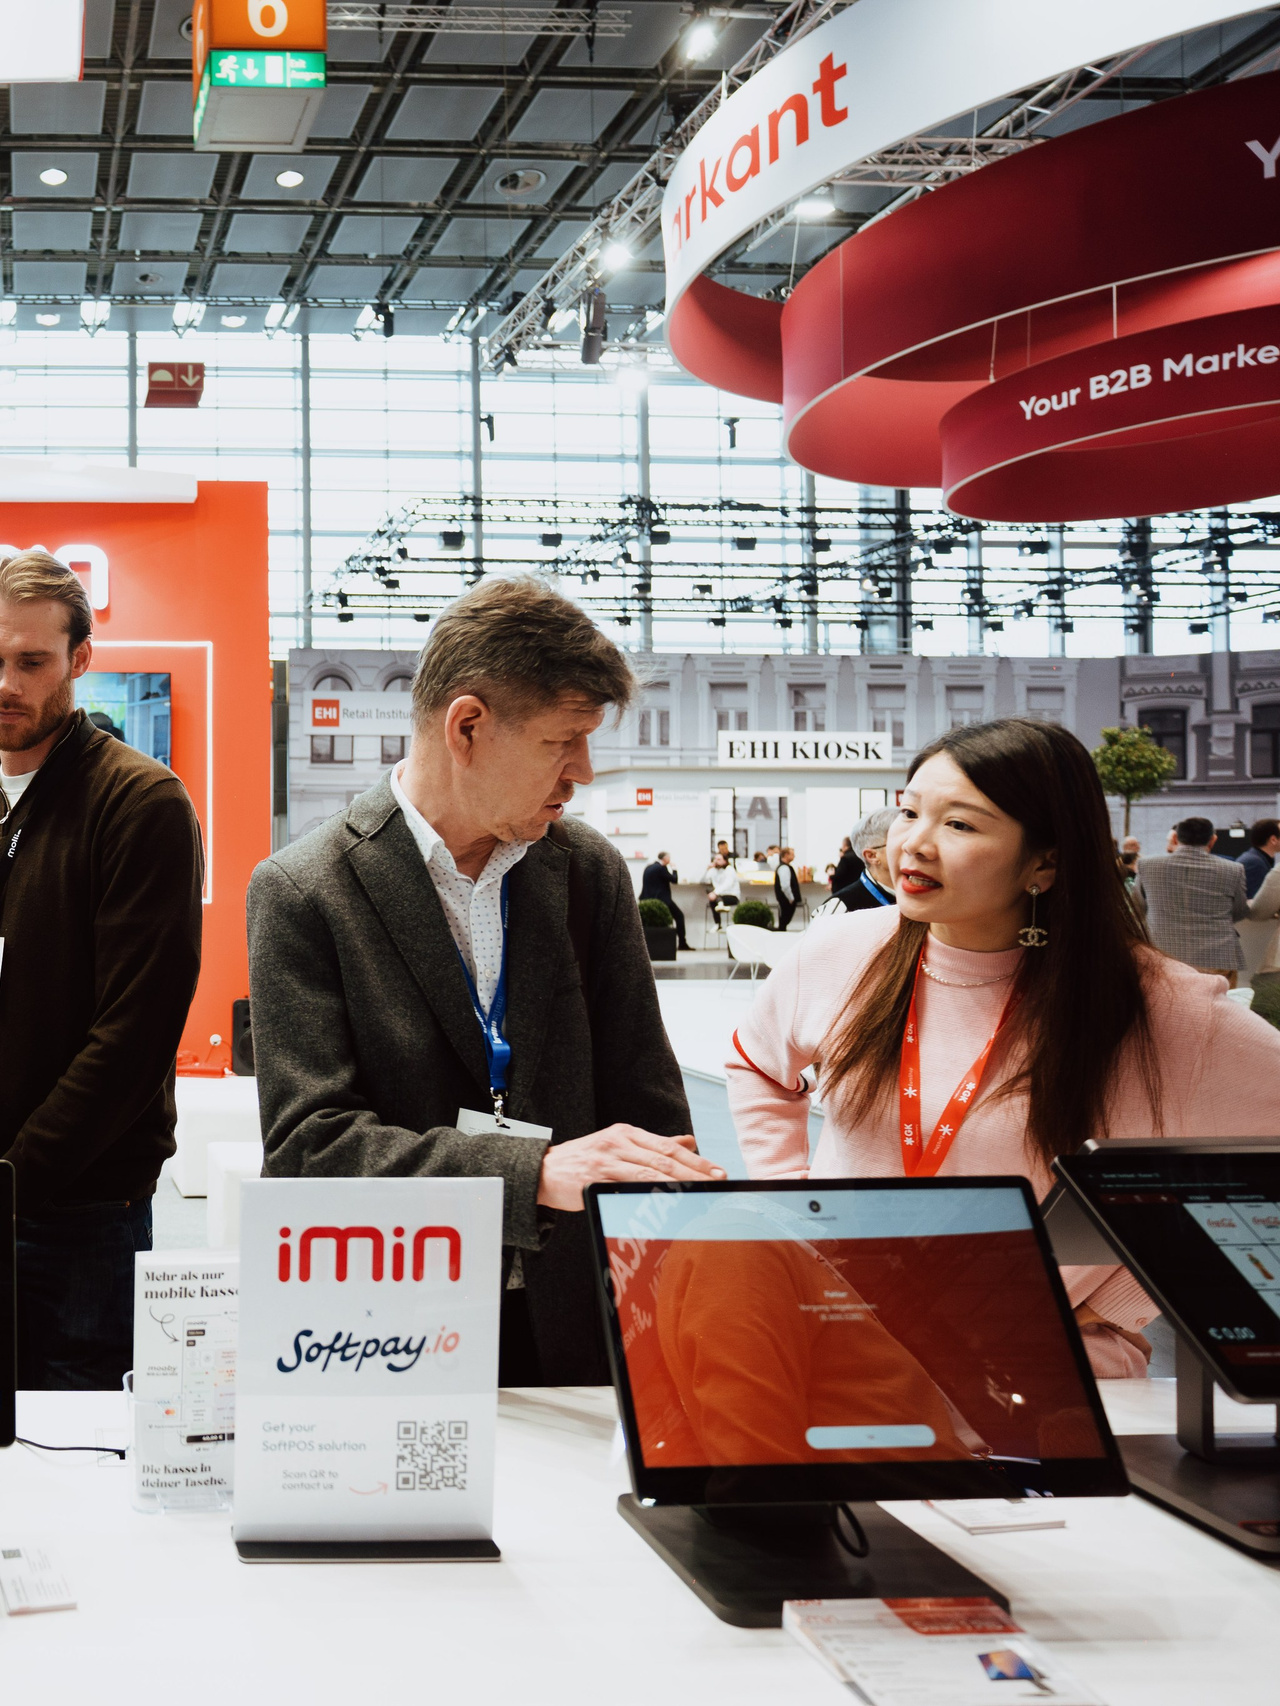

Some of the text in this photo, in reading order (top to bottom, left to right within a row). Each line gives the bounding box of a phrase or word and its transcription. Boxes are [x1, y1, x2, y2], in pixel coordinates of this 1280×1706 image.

[1019, 387, 1081, 421] Your
[1089, 364, 1152, 400] B2B
[314, 706, 337, 720] EHI
[342, 707, 373, 719] Retail
[728, 740, 883, 760] EHI KIOSK
[637, 792, 652, 802] EHI
[904, 1122, 913, 1138] GK
[278, 1225, 461, 1283] imin
[144, 1271, 225, 1281] Mehr als nur
[144, 1286, 196, 1299] mobile
[276, 1324, 460, 1373] Softpay.io
[262, 1422, 317, 1438] Get your
[262, 1440, 367, 1452] SoftPOS solution
[142, 1463, 211, 1474] Die Kasse in
[282, 1469, 339, 1480] Scan QR to
[141, 1478, 181, 1488] deiner
[282, 1481, 335, 1490] contact us
